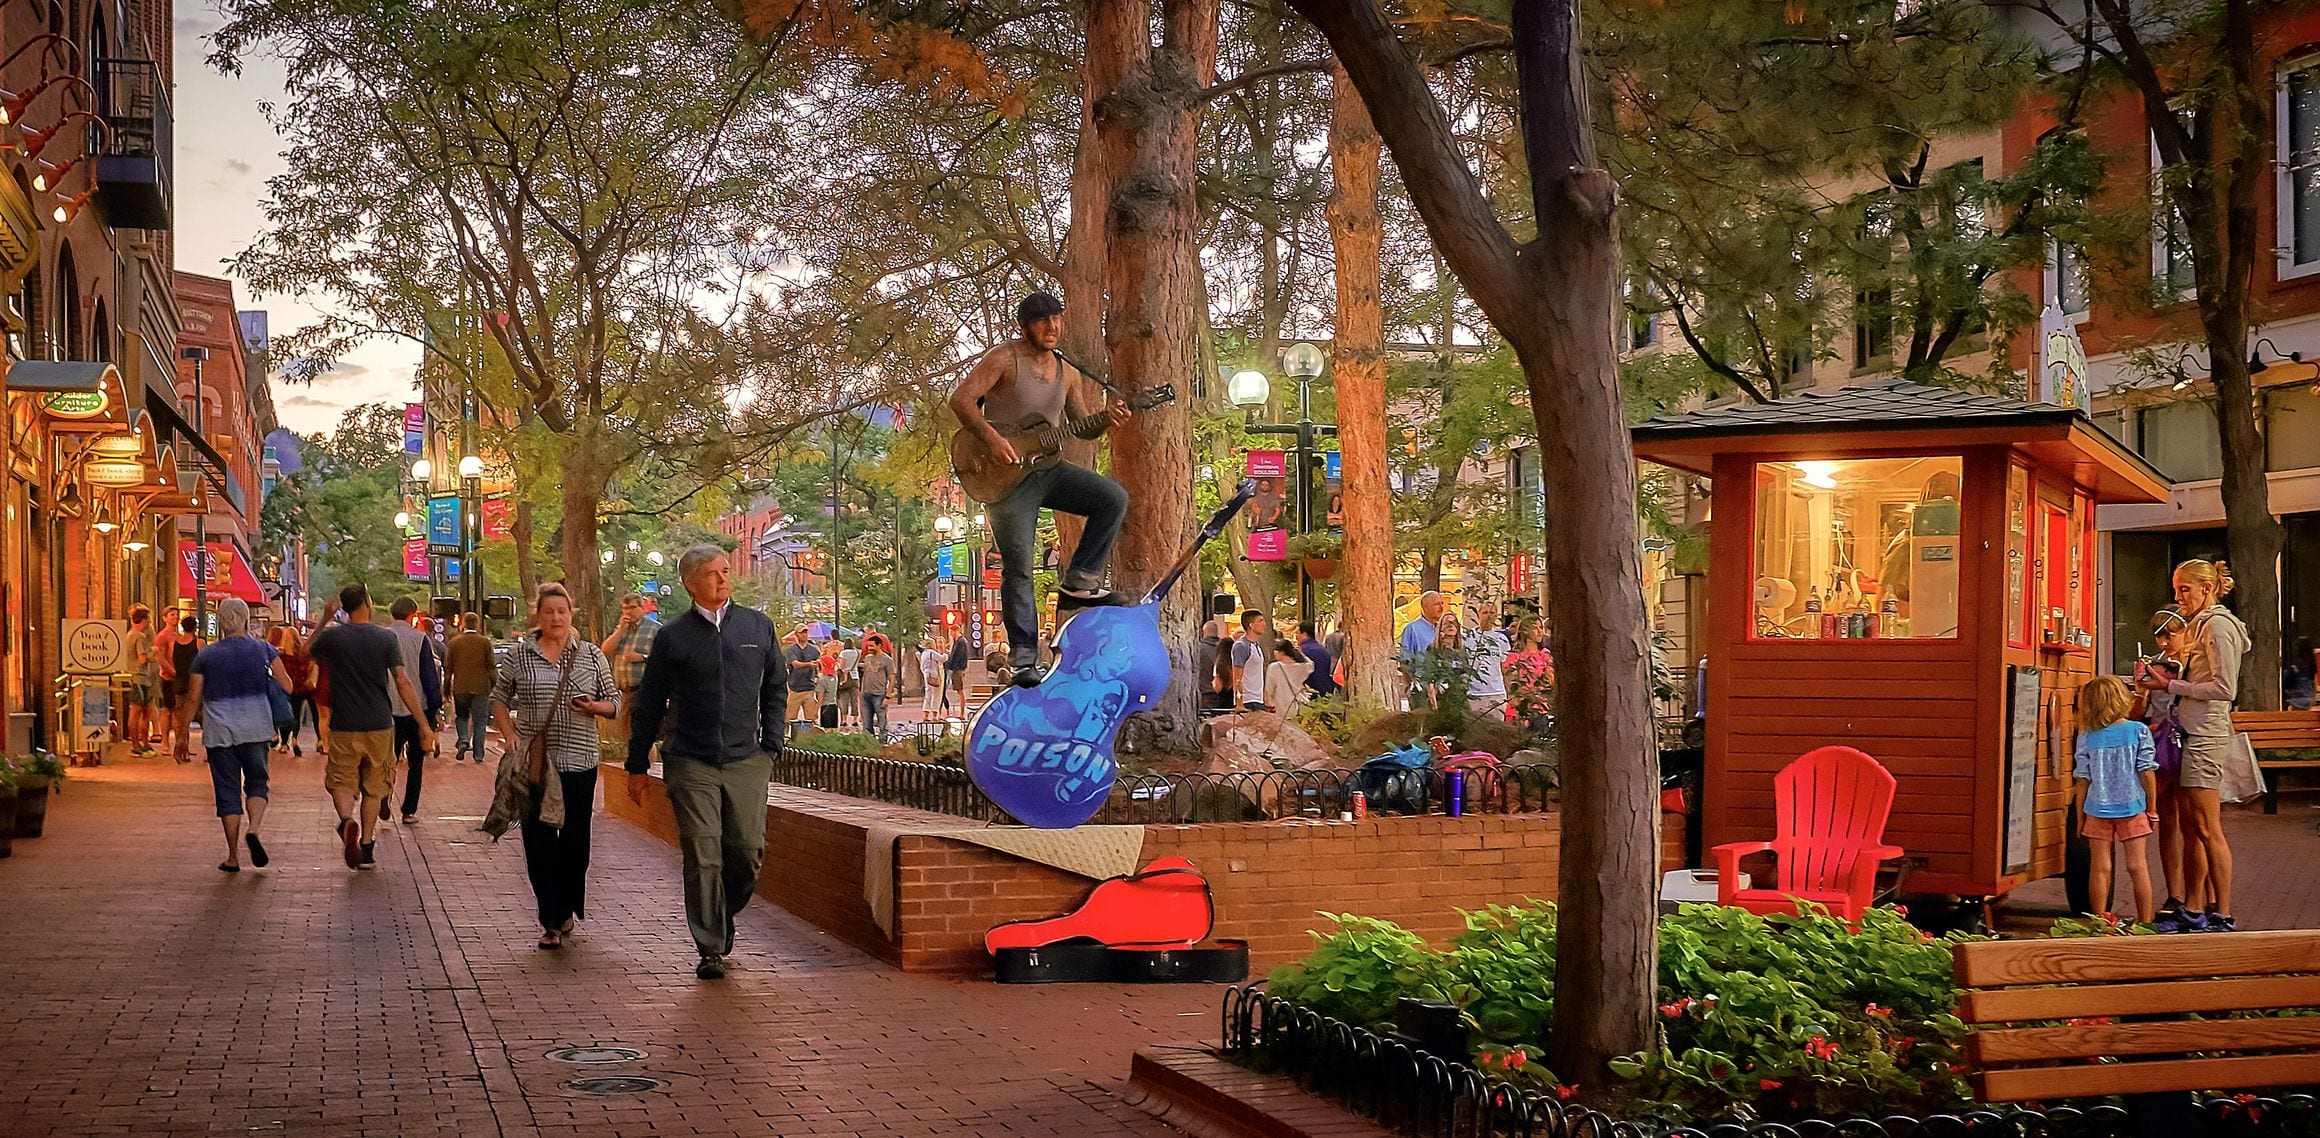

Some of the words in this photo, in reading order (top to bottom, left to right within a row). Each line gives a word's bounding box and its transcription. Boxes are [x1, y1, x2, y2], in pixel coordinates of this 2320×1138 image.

[81, 641, 108, 651] book
[82, 653, 109, 665] shop
[975, 723, 1112, 784] POISON
